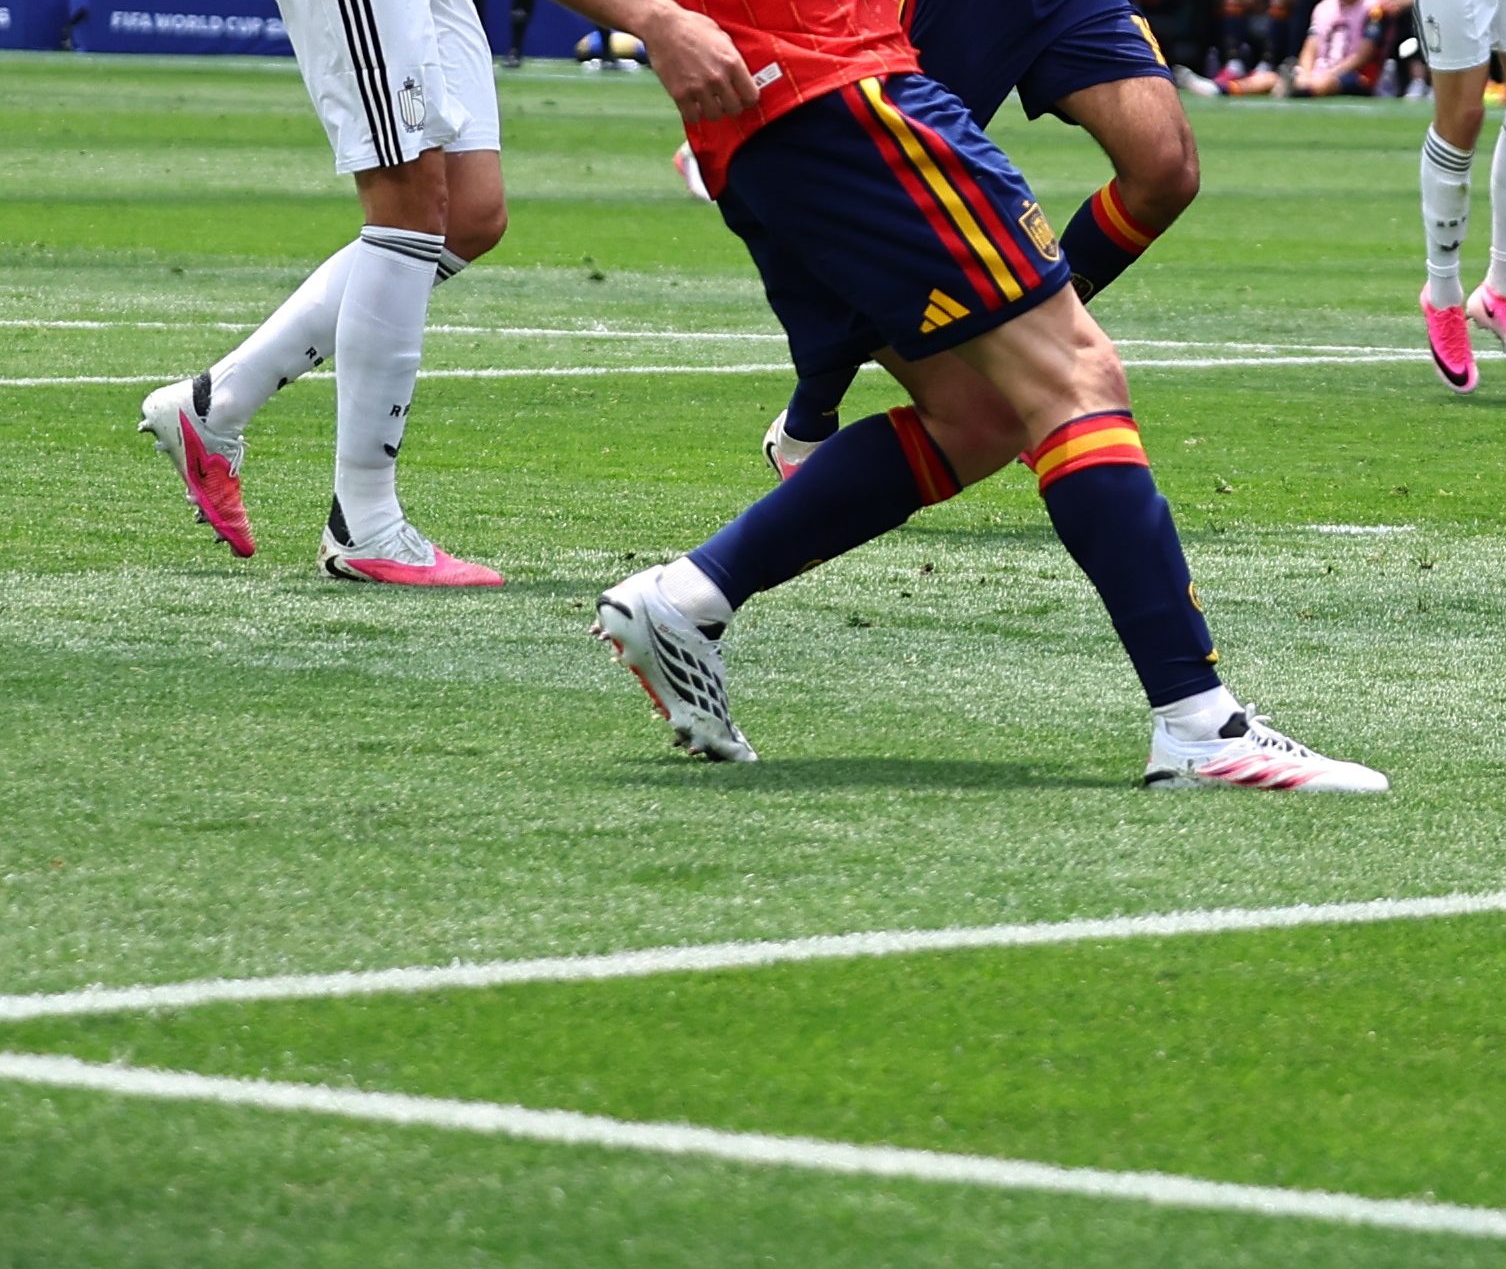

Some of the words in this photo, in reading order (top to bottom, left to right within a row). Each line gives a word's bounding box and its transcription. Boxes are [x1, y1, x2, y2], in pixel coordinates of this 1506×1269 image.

[110, 11, 152, 30] FIFA
[155, 13, 223, 32] WORLD
[226, 15, 263, 37] CUP
